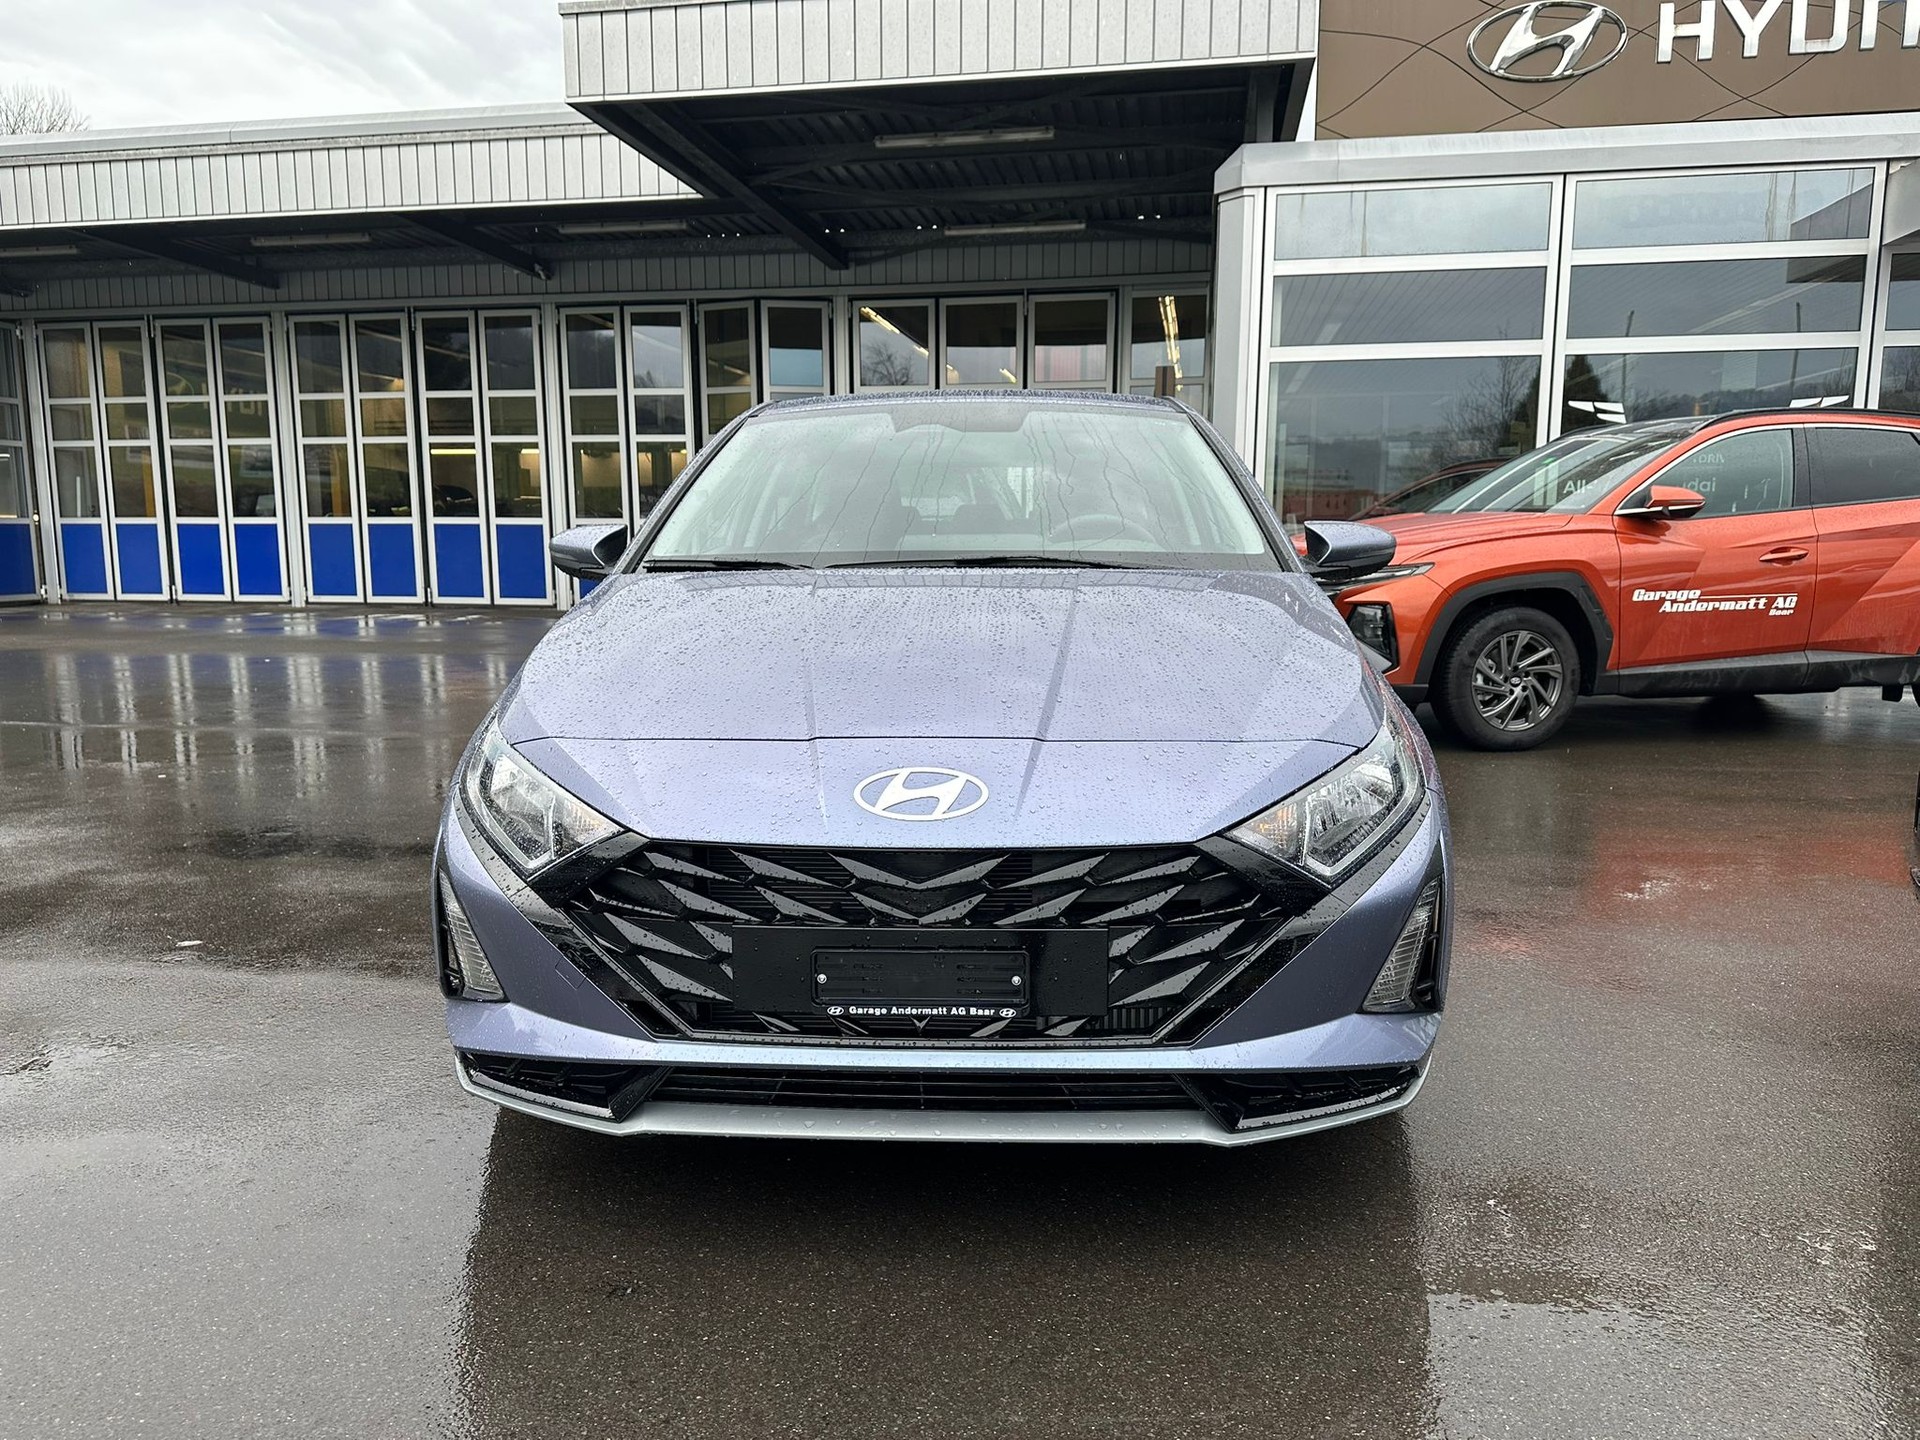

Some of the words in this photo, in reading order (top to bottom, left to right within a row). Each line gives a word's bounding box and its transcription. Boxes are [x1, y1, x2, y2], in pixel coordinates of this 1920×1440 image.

[1632, 589, 1701, 601] Garage
[1659, 598, 1767, 613] Andermatt
[1771, 596, 1798, 609] AG
[849, 1006, 887, 1015] Garage
[891, 1006, 947, 1015] Andermatt
[950, 1007, 966, 1016] AG
[970, 1007, 995, 1016] Baar
